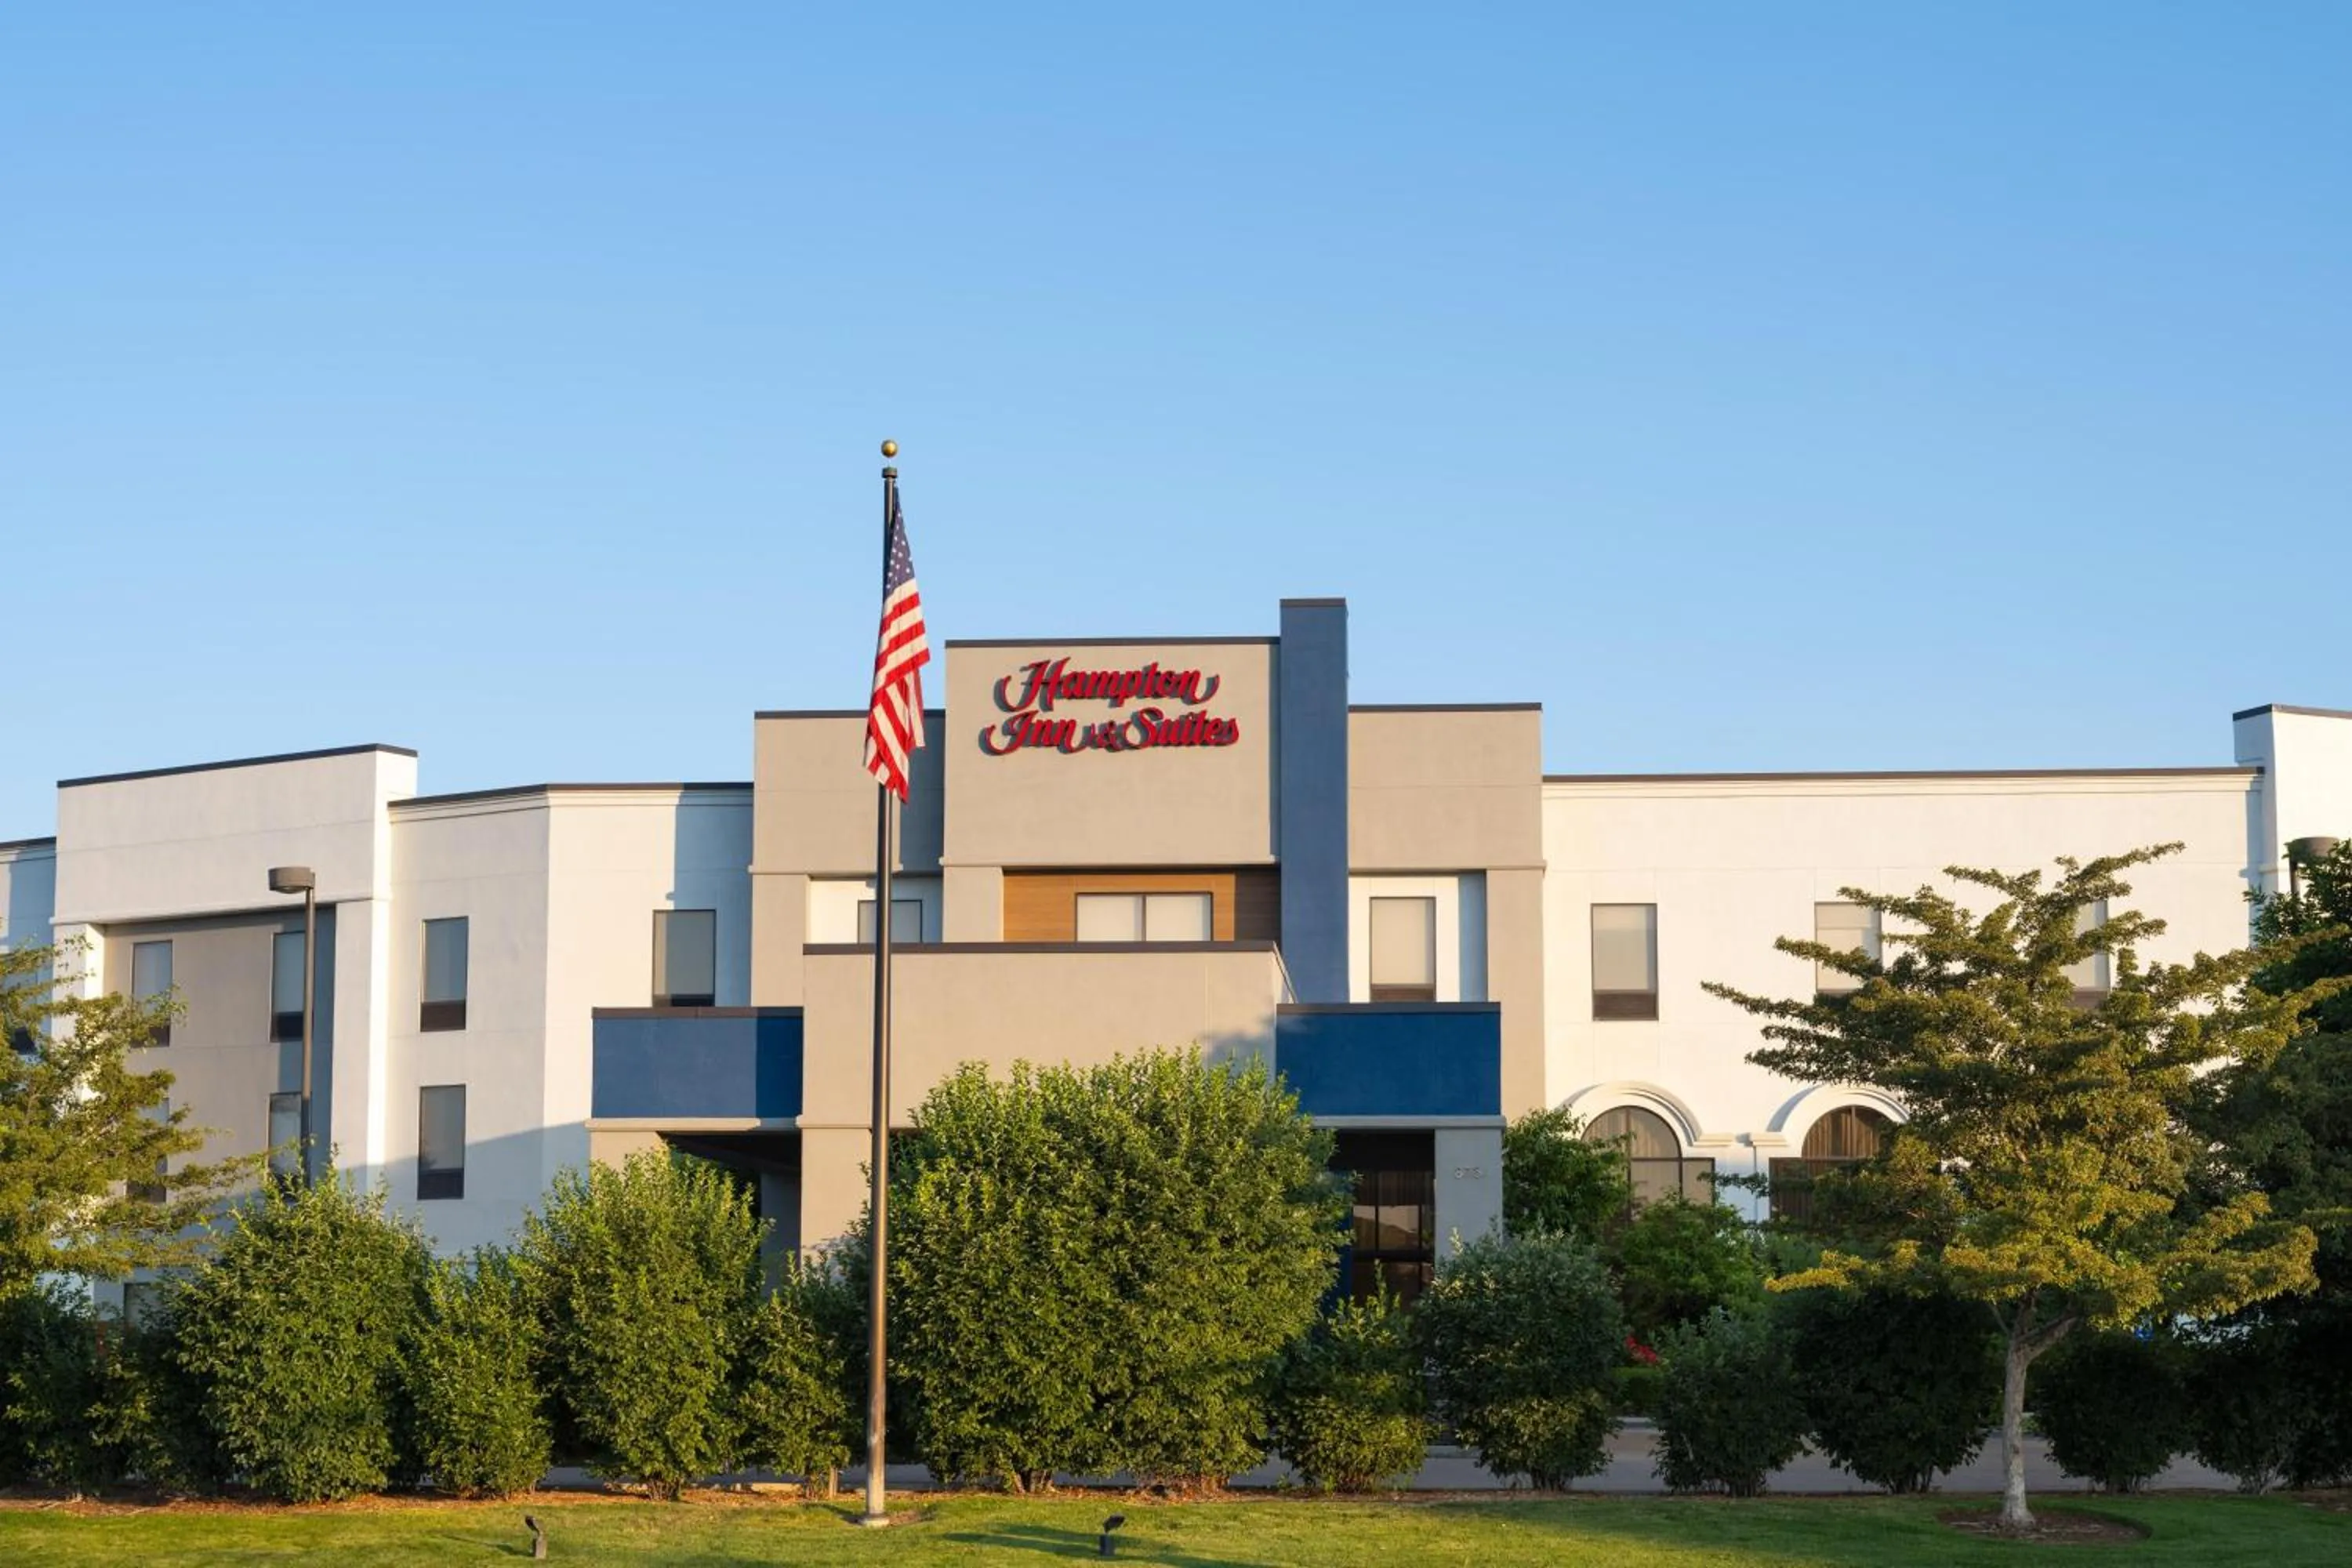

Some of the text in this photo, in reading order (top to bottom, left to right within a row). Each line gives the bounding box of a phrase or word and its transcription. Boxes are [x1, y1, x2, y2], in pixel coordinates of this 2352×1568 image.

[1002, 657, 1221, 711] Hampton
[984, 706, 1240, 753] Inn & Suites
